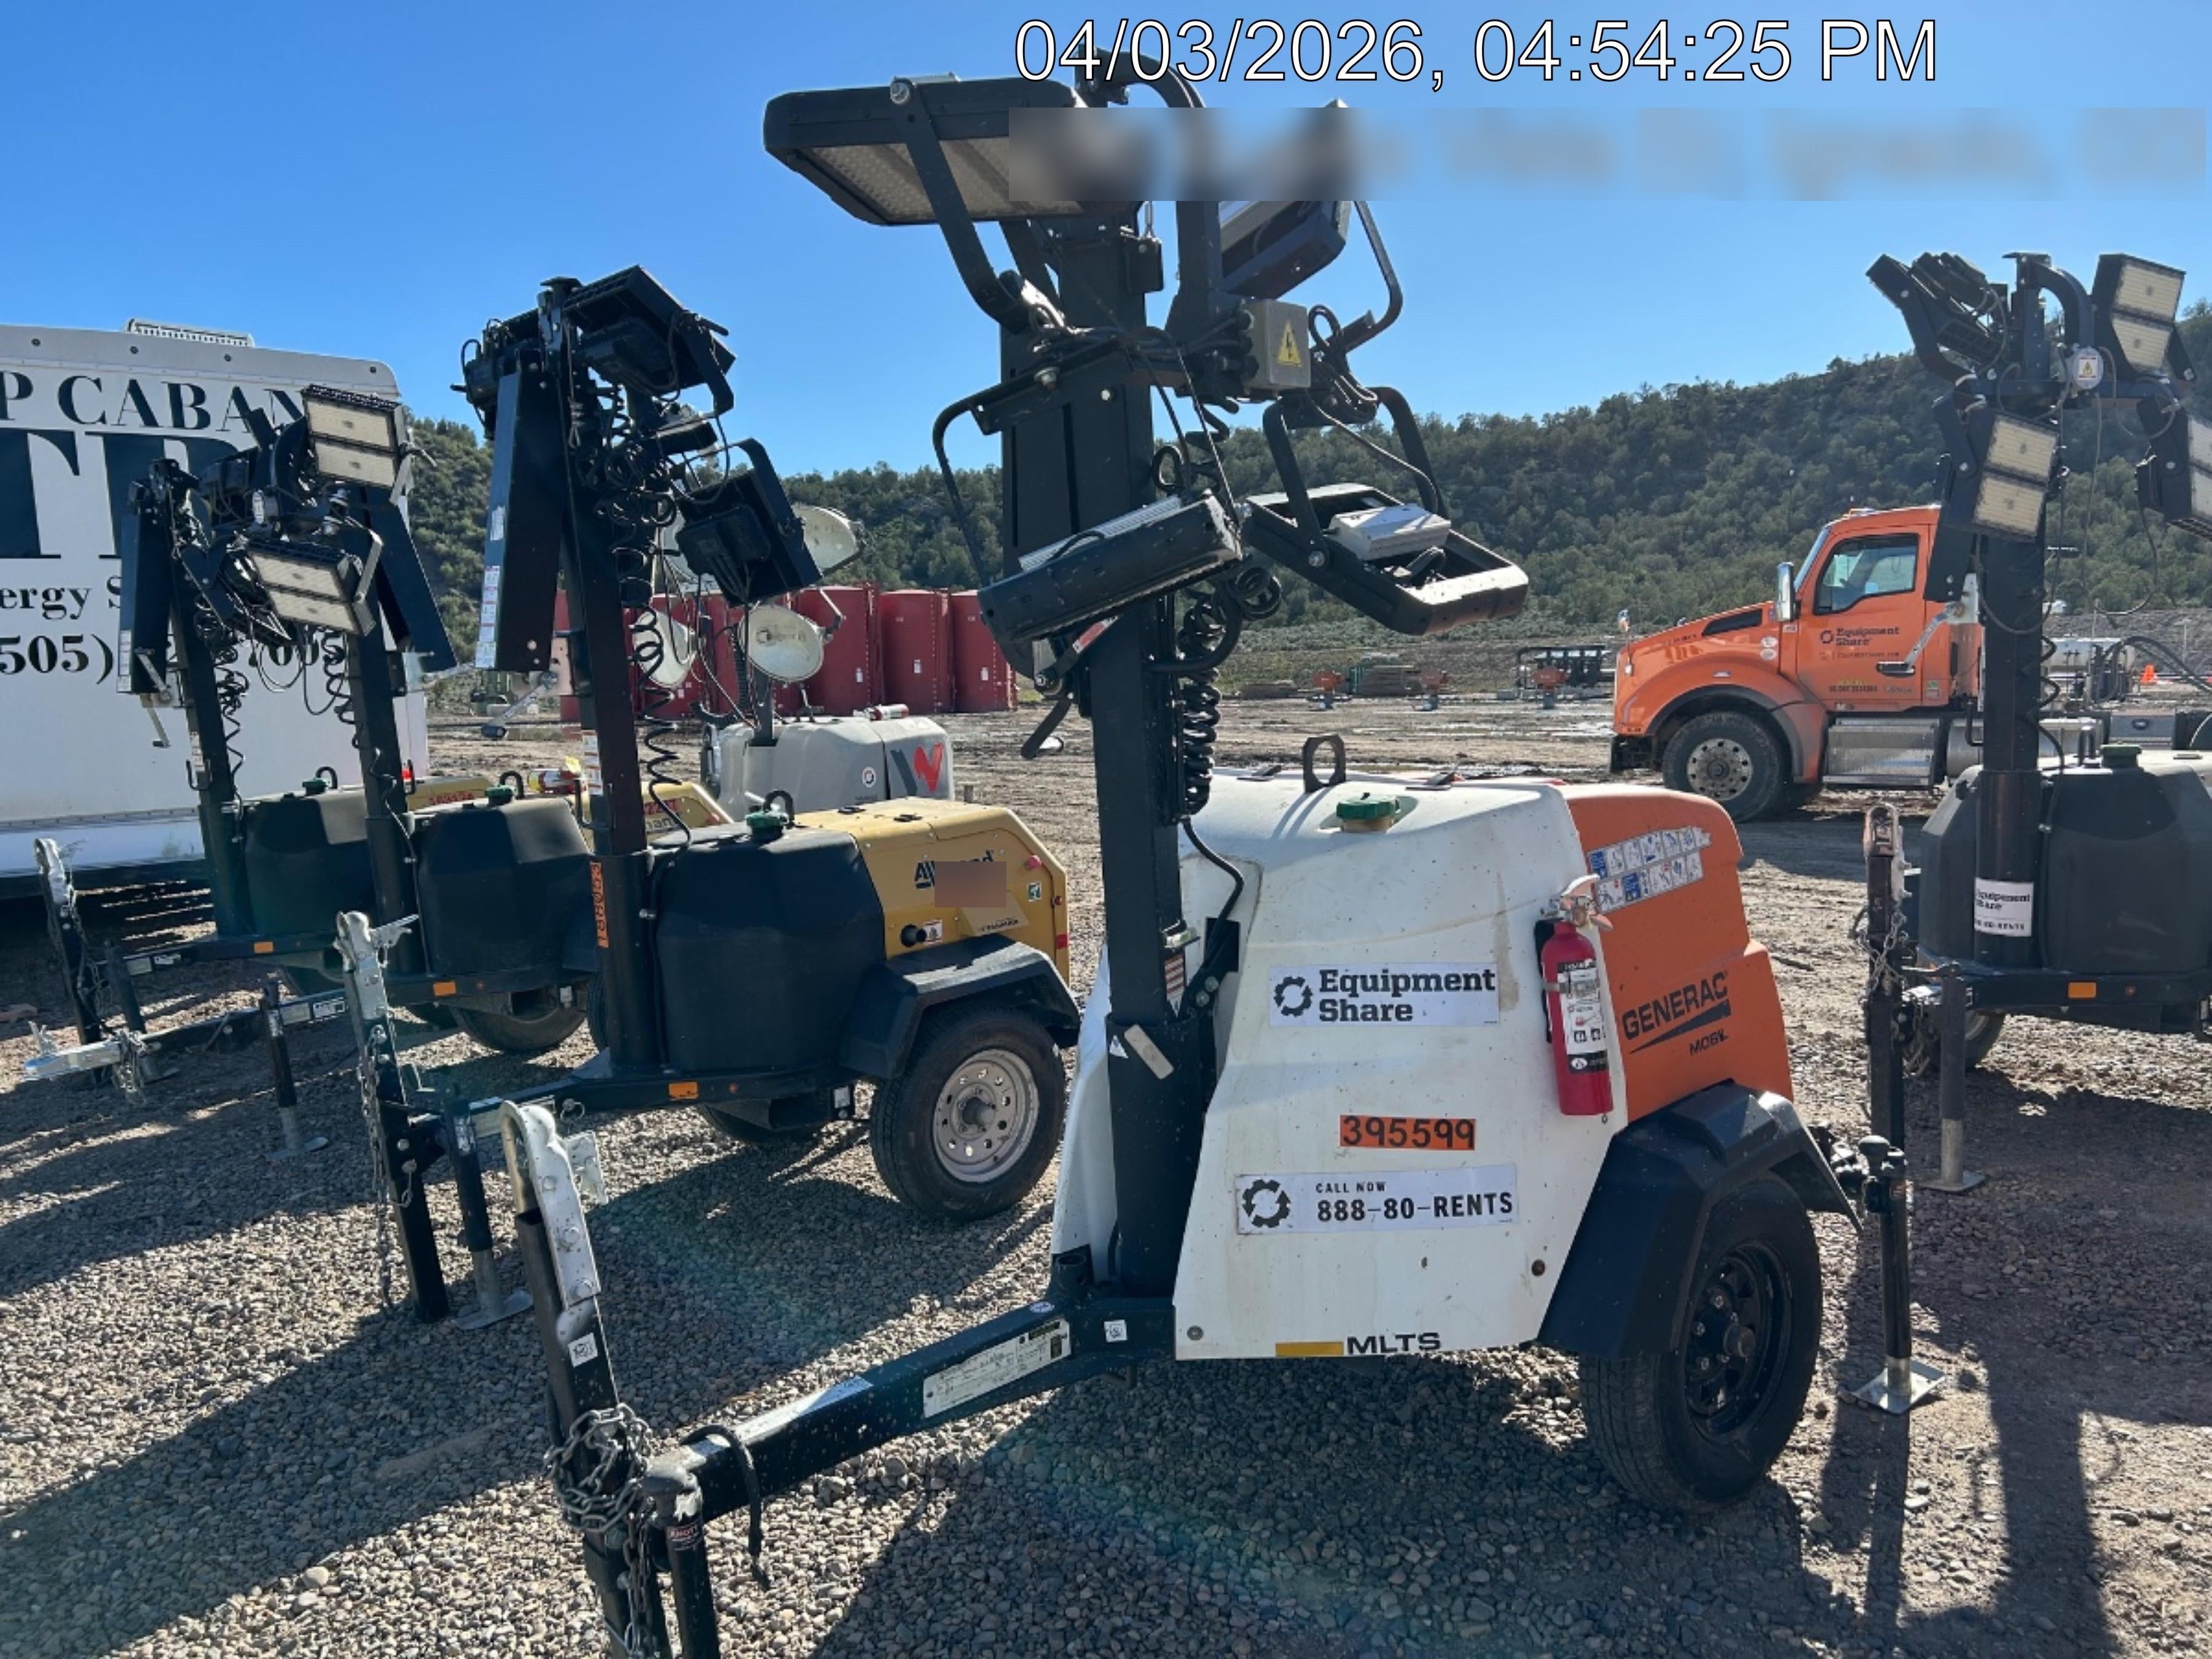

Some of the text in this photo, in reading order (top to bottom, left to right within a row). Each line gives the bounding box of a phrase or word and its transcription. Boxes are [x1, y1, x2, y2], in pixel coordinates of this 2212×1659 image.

[1319, 968, 1496, 998] Equipment
[1319, 999, 1413, 1022] Share
[1622, 971, 1728, 1040] GENERAC
[1343, 1115, 1474, 1148] 395599
[1316, 1182, 1386, 1193] CALL NOW
[1317, 1192, 1513, 1222] 888-80-RENTS
[1347, 1333, 1441, 1354] MLTS
